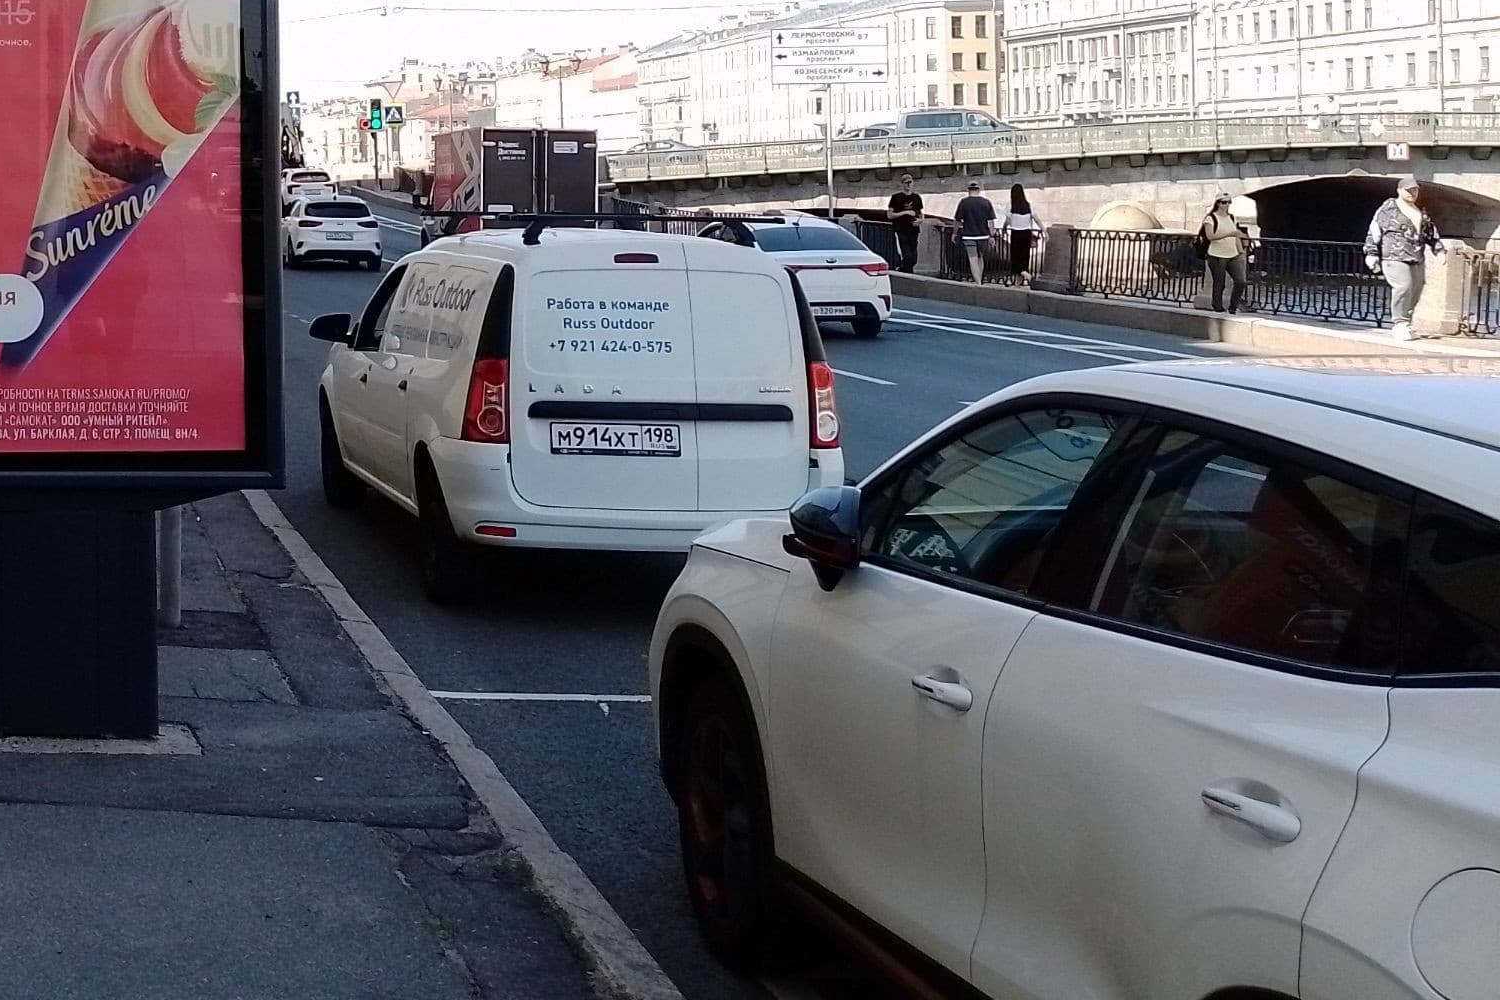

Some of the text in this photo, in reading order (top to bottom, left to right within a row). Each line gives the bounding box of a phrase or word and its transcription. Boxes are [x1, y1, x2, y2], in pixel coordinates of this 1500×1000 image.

[791, 30, 856, 39] ЛЕРМОНТОВСКИЙ
[792, 48, 855, 57] ИЗМАЙЛОВСКИЙ
[794, 66, 854, 75] ВОЗНЕСЕНСКИЙ
[546, 298, 670, 312] Работа в команде
[563, 318, 656, 330] Russ Outdoor
[548, 340, 672, 353] +7 921 424-0-575
[47, 388, 60, 400] НА
[9, 402, 16, 413] И
[19, 402, 53, 413] ТОЧНОЕ
[54, 402, 86, 413] ВРЕМЯ
[87, 402, 136, 414] ДОСТАВКИ
[138, 400, 189, 413] УТОЧНЯЙТЕ
[61, 414, 81, 426] ООО
[30, 428, 77, 440] БАРКЛАЯ,
